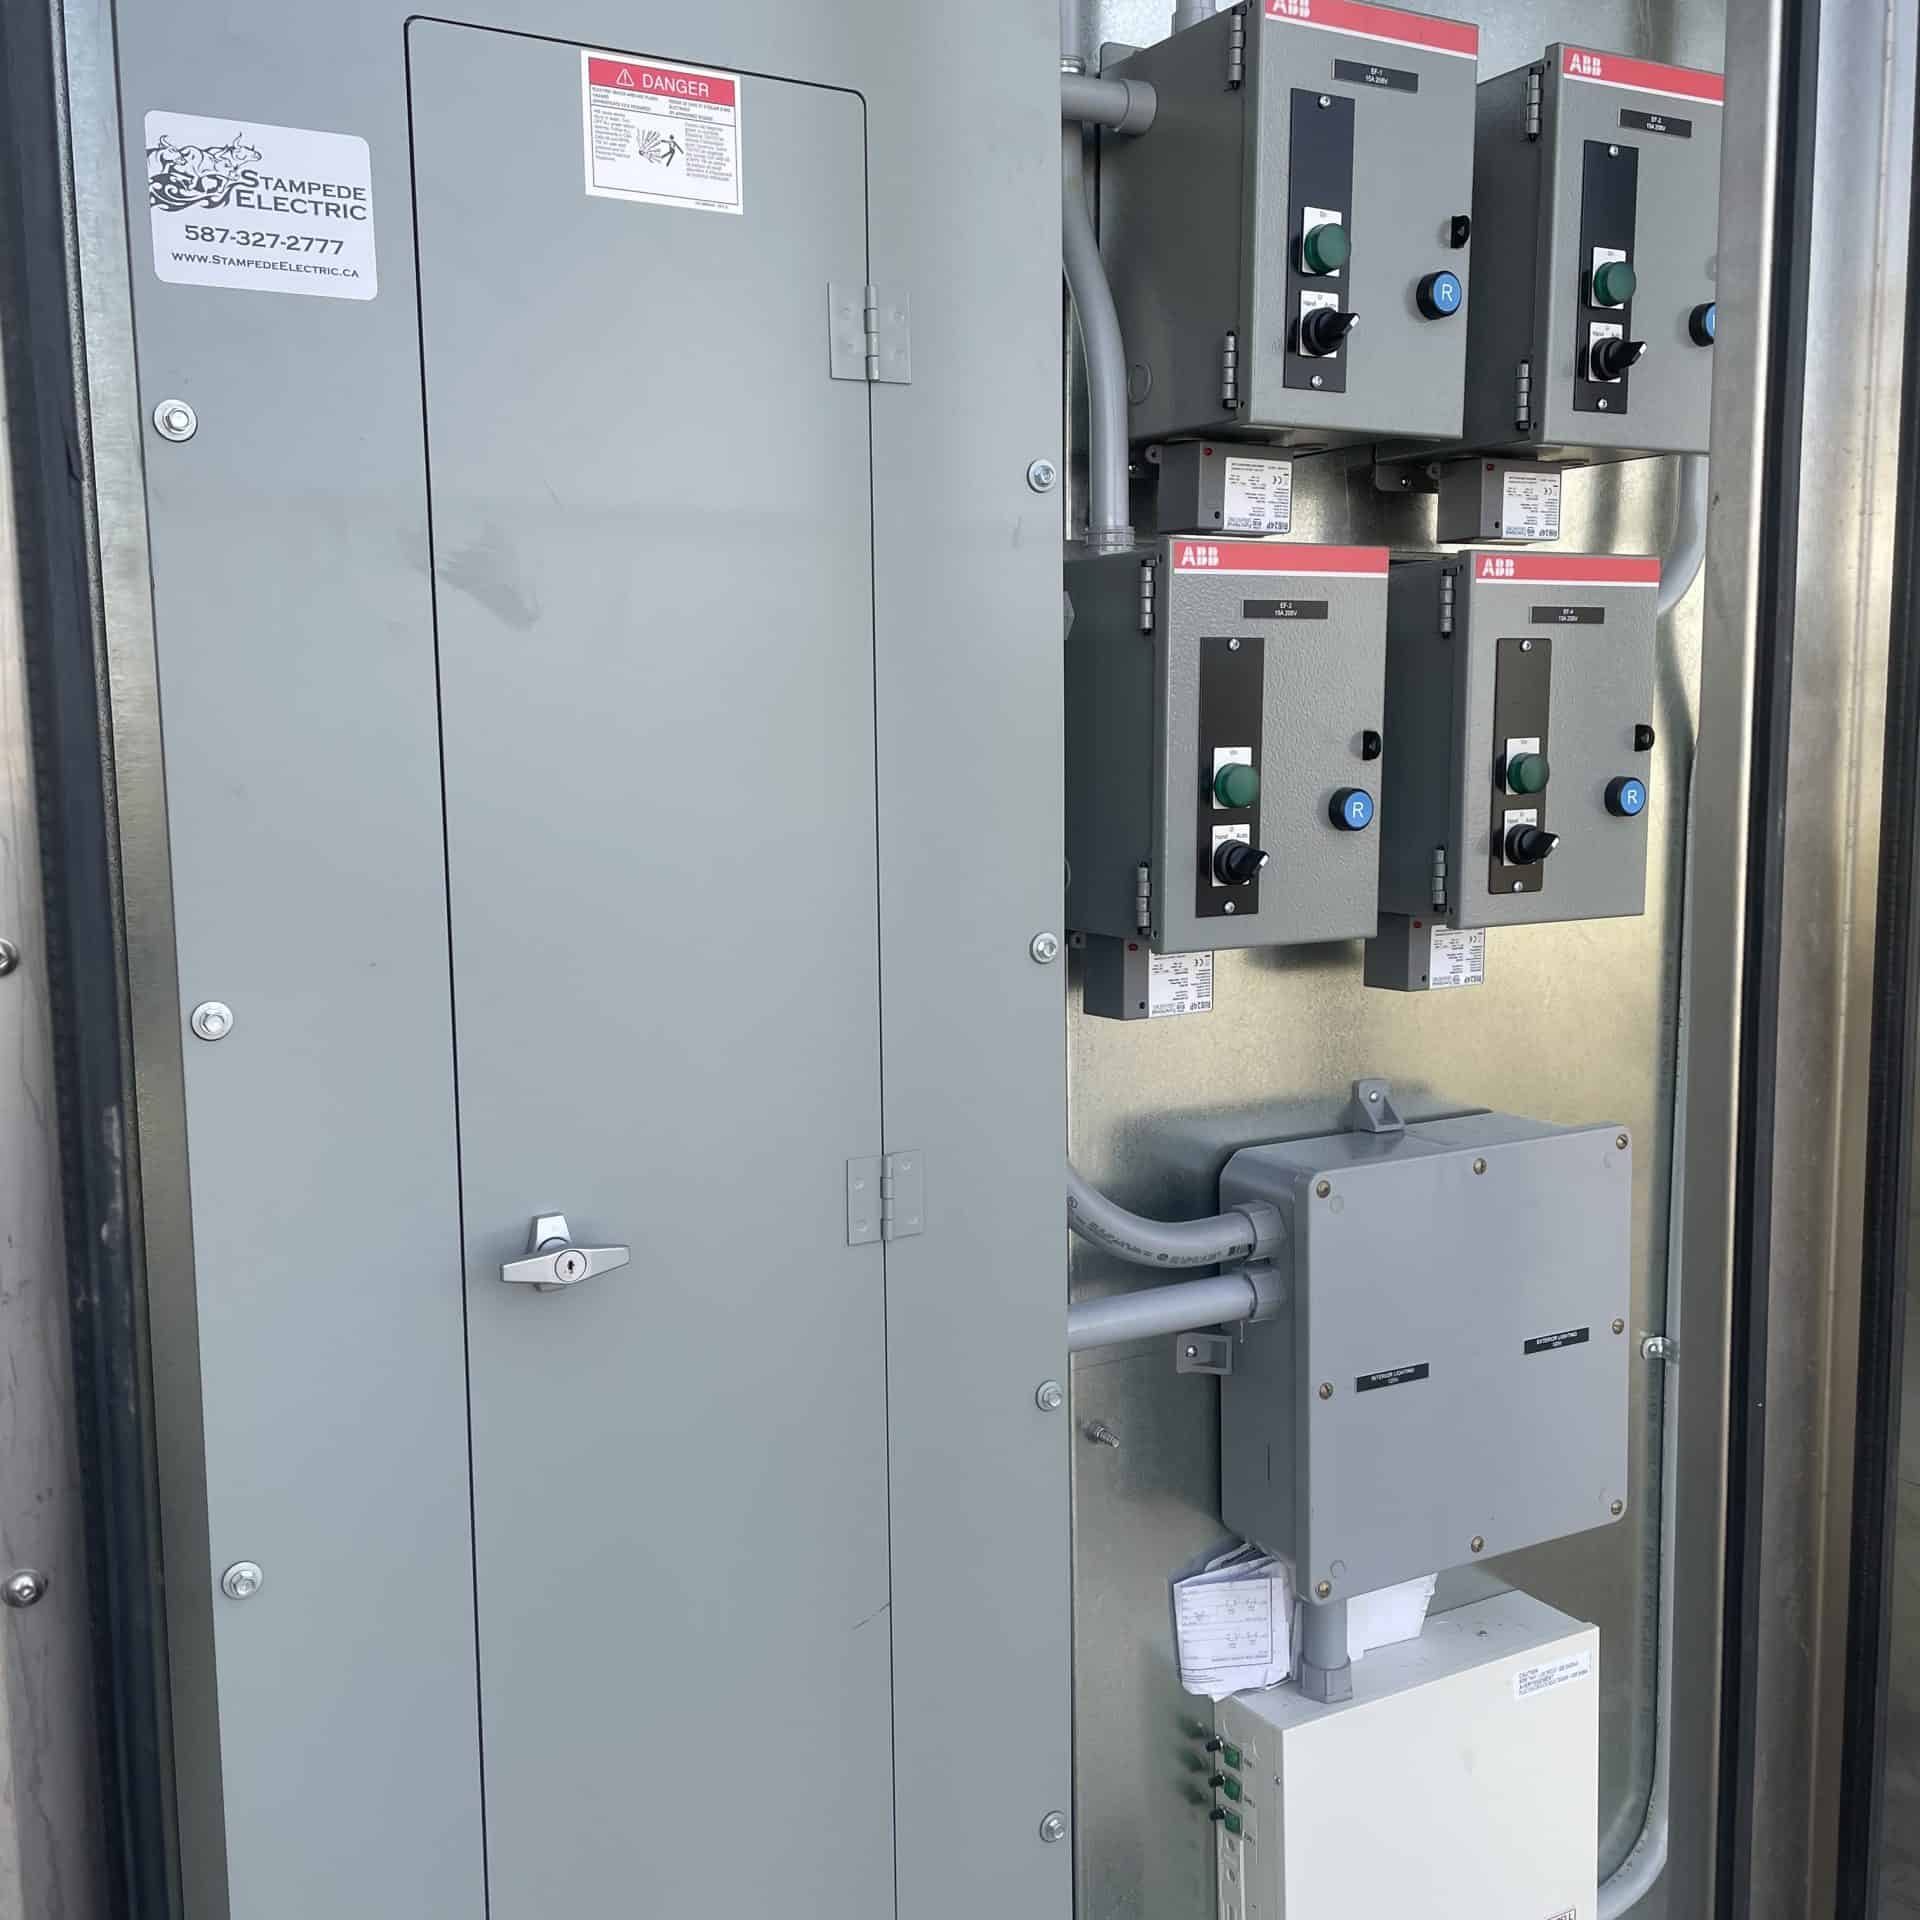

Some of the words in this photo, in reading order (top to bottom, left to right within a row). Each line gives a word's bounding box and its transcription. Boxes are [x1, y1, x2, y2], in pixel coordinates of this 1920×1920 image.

[1272, 0, 1310, 17] ABB
[1569, 53, 1602, 76] ABB
[642, 73, 710, 97] DANGER
[184, 225, 344, 255] 587-327-2777
[1441, 283, 1453, 302] R
[1181, 546, 1220, 567] ABB
[1482, 558, 1515, 577] ABB
[1627, 790, 1638, 805] R
[1352, 801, 1364, 819] R
